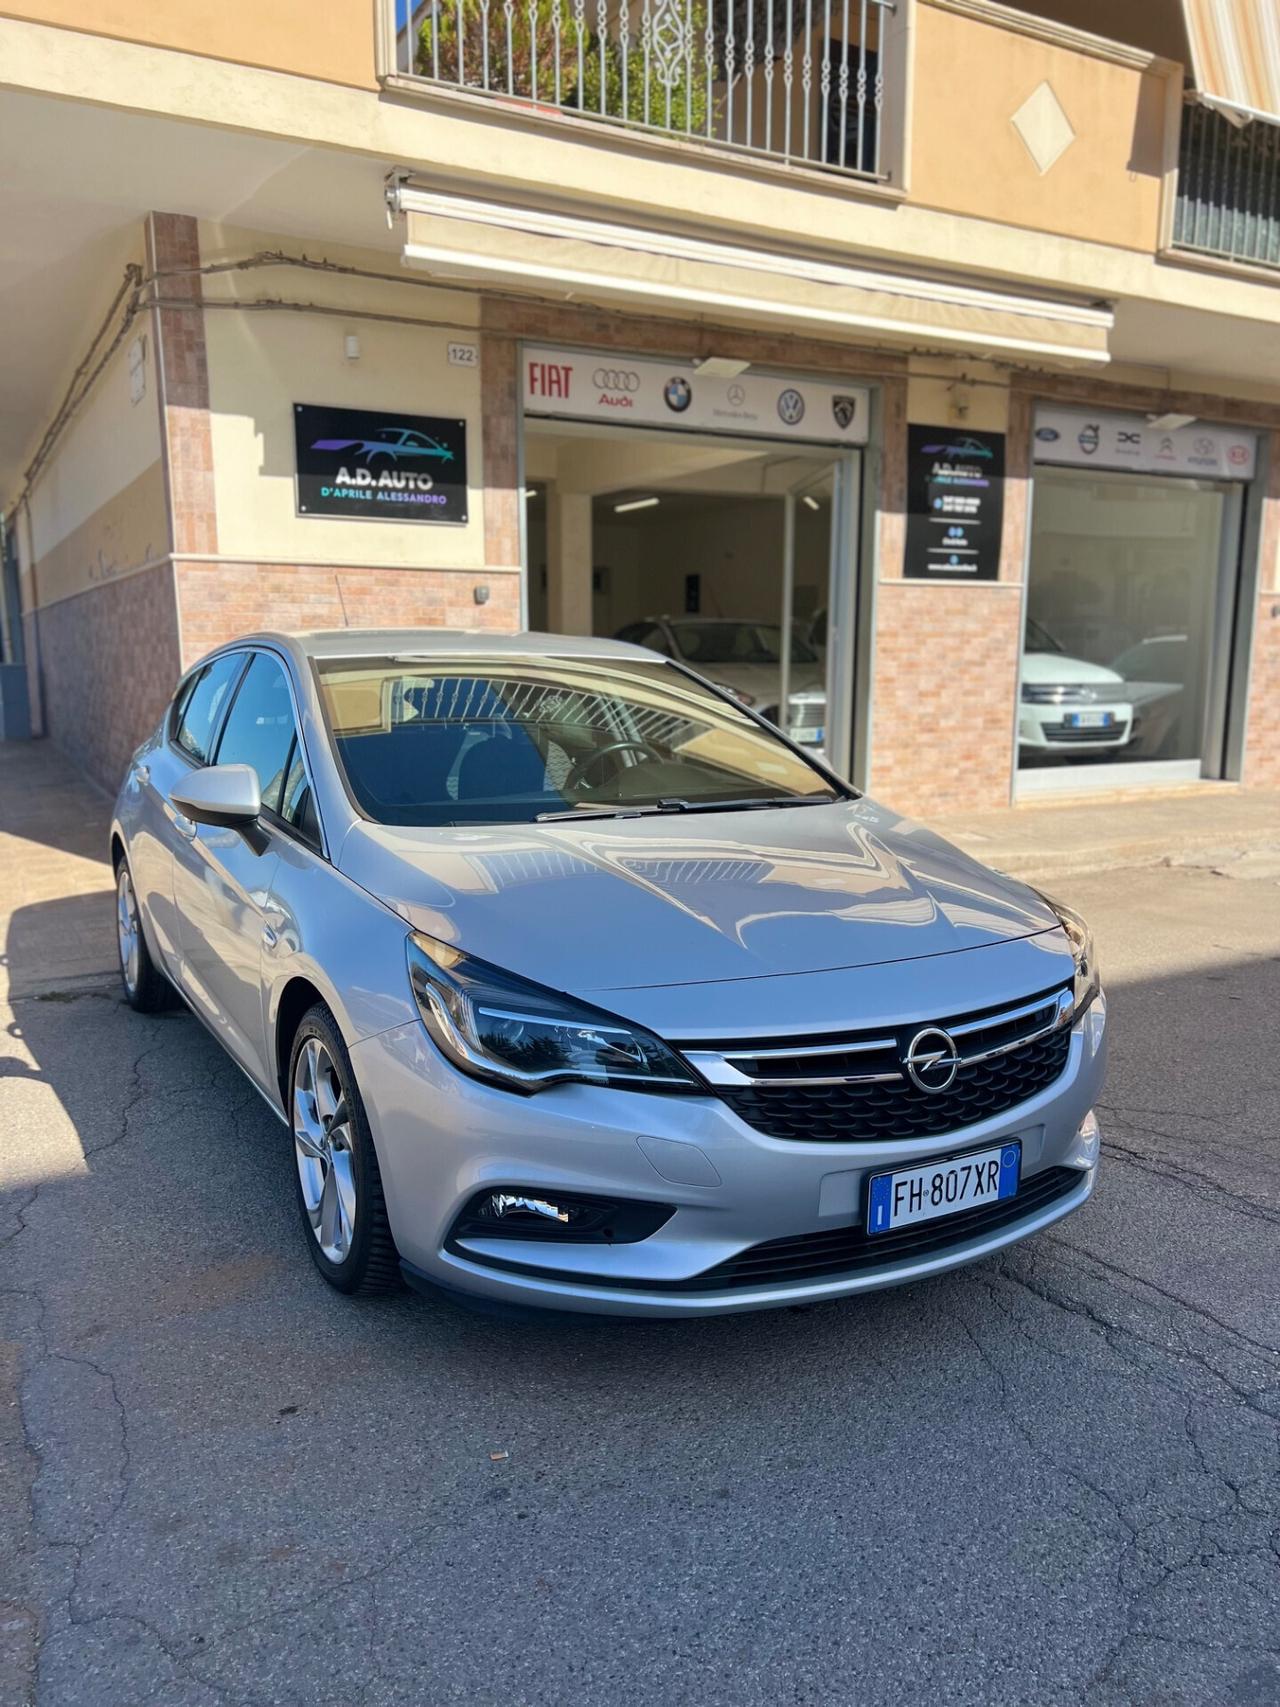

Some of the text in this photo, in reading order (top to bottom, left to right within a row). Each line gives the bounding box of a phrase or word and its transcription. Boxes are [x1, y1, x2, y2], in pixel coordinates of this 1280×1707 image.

[452, 349, 473, 361] 122
[529, 362, 573, 399] FIAT
[598, 394, 633, 408] Audi
[320, 487, 447, 505] D'APRILE ALESSANDRO
